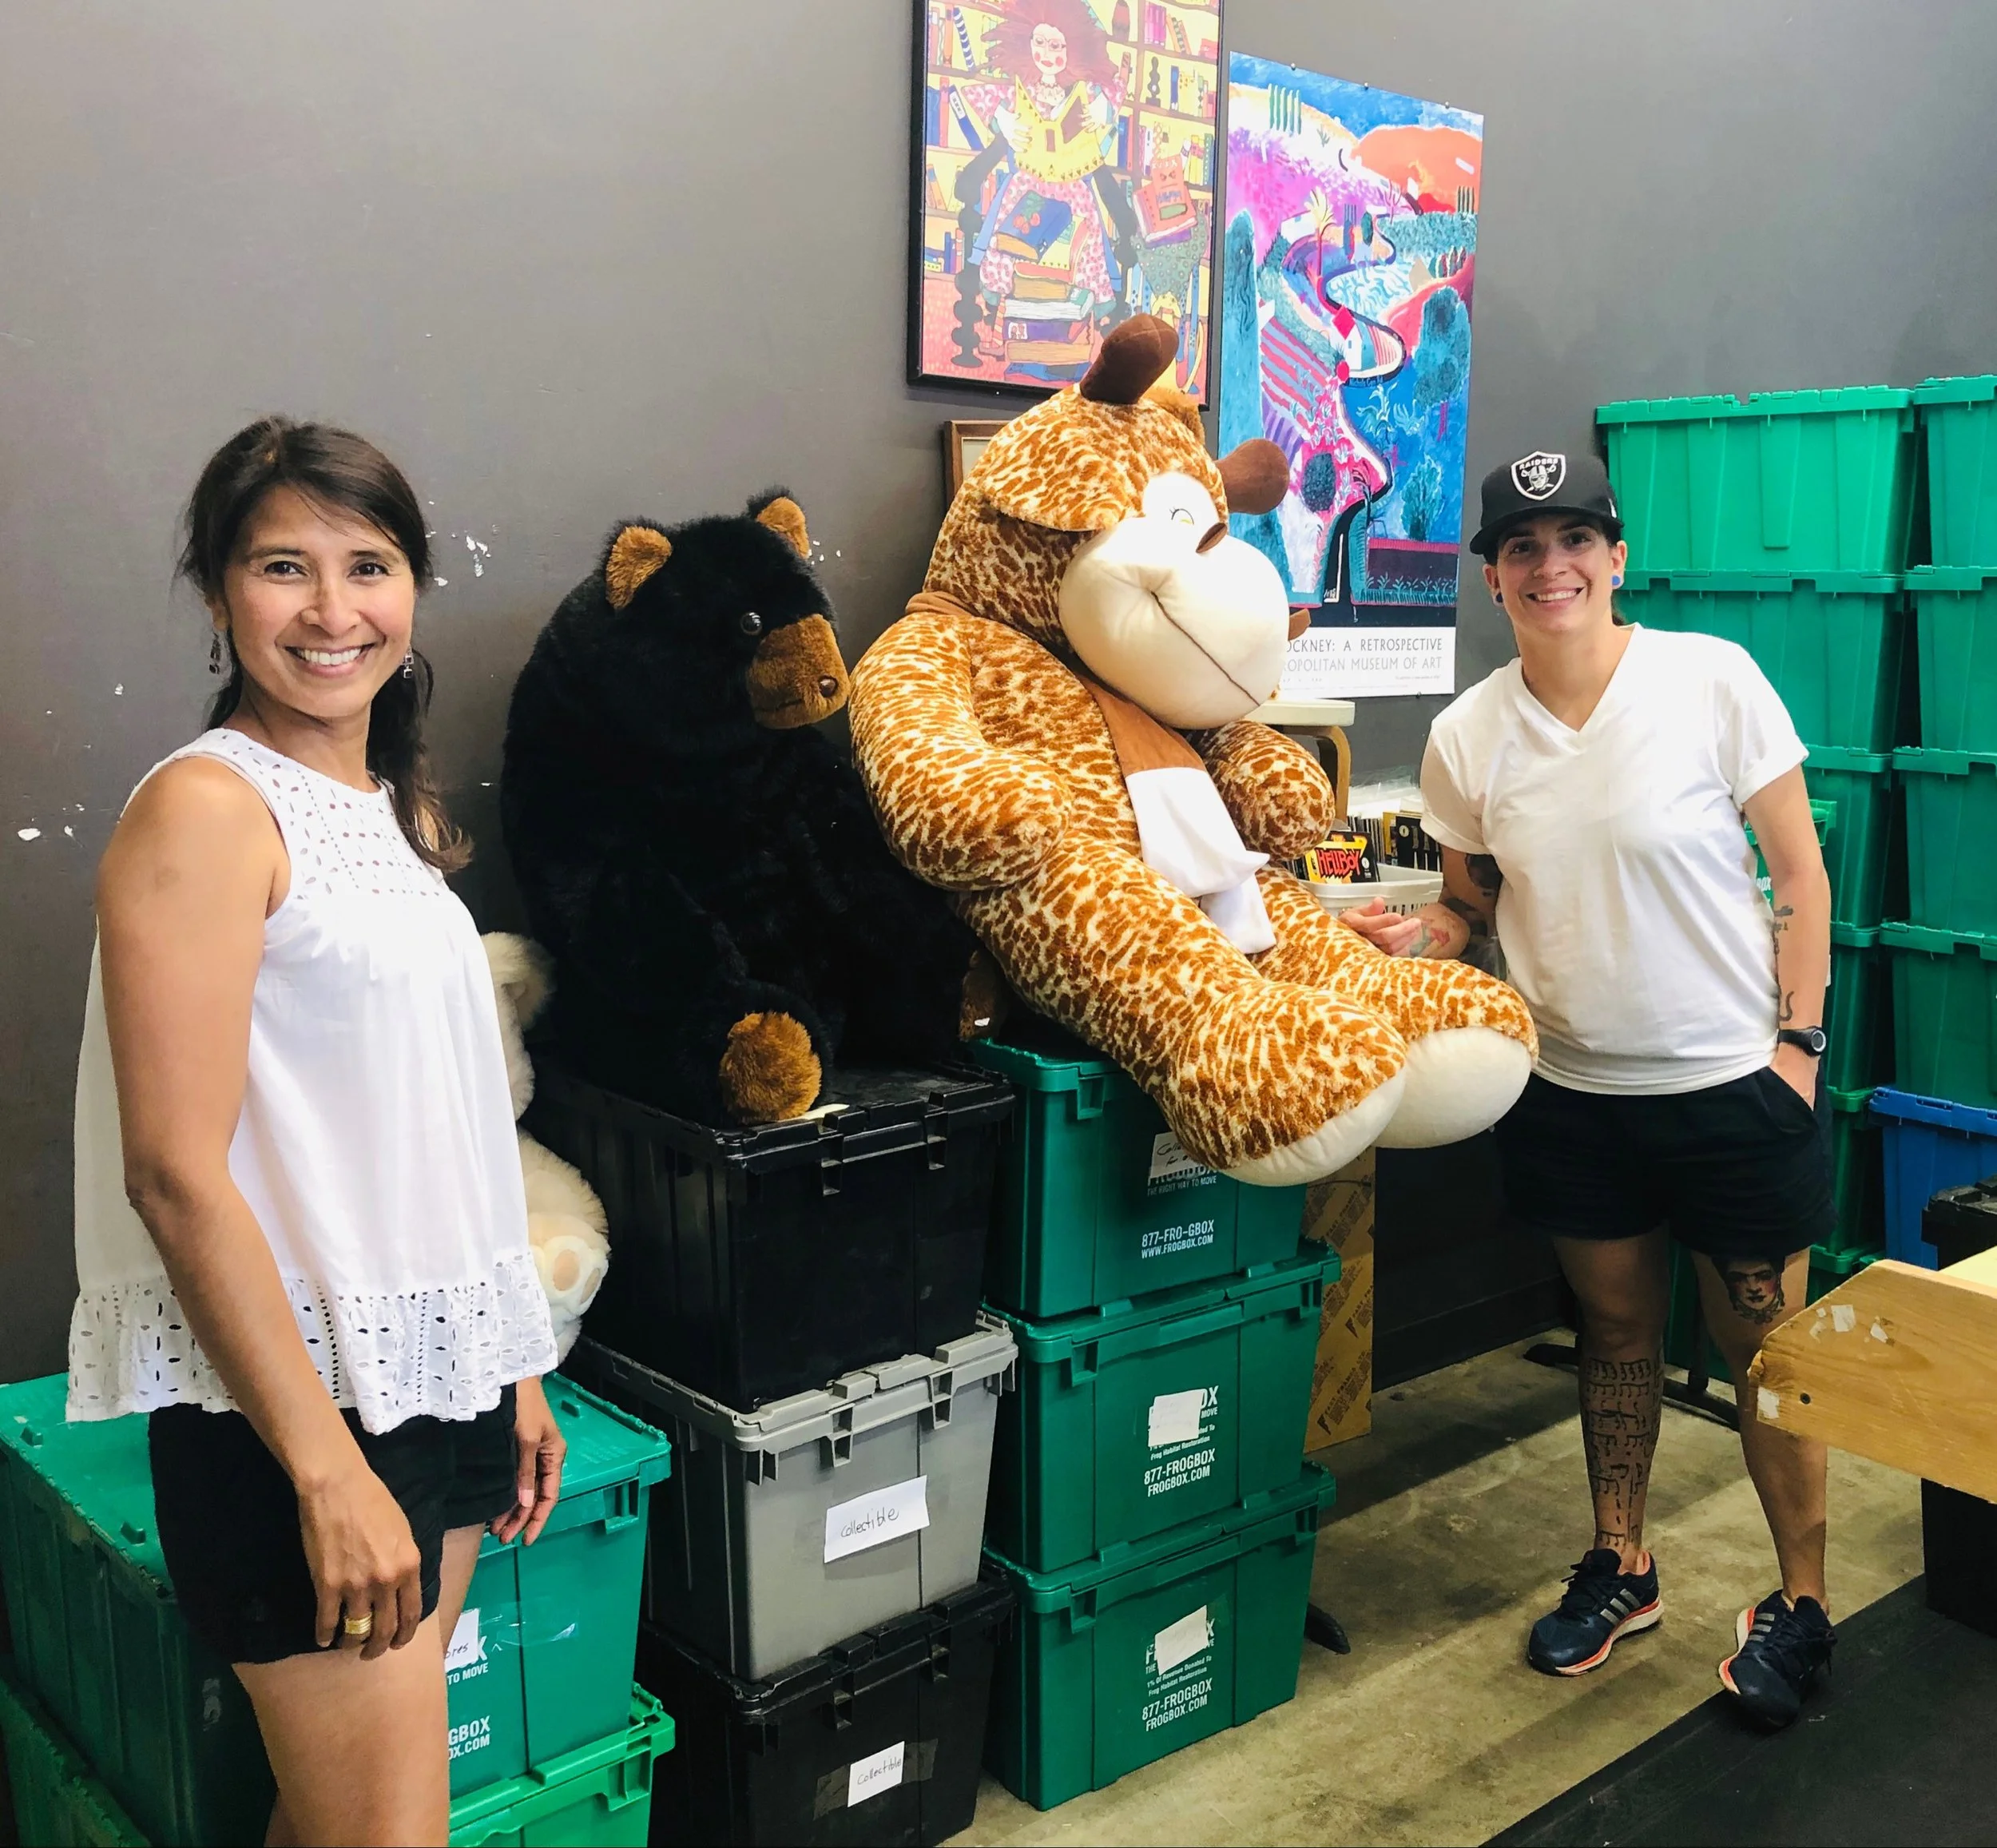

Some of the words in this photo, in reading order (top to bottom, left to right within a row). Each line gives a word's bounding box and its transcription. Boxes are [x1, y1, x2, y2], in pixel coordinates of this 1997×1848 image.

[1519, 458, 1558, 470] RAIDERS
[1286, 639, 1335, 652] OCKNEY:
[1344, 640, 1352, 651] A
[1360, 638, 1442, 651] RETROSPECTIVE
[1284, 658, 1345, 671] OPOLITAN
[1352, 658, 1398, 670] MUSEUM
[1403, 657, 1417, 669] OF
[1422, 657, 1442, 669] ART
[1316, 848, 1360, 878] HELLBOY
[1147, 1187, 1157, 1197] THE
[1158, 1182, 1176, 1194] RIGHT
[1177, 1179, 1190, 1190] WAY
[1192, 1178, 1200, 1187] TO
[1201, 1175, 1217, 1186] MOVE
[1141, 1219, 1214, 1247] 877-FRO-GBOX
[1141, 1234, 1213, 1259] WWW.FROGBOX.COM
[1201, 1407, 1218, 1419] MOVE
[1150, 1452, 1163, 1461] Frog
[1163, 1445, 1181, 1457] Habitat
[1144, 1449, 1215, 1484] 877-FROGBOX
[1148, 1465, 1210, 1497] FROGBOX.COM
[447, 1672, 460, 1685] TO
[463, 1663, 489, 1680] MOVE
[1145, 1663, 1157, 1675] THE
[1184, 1657, 1205, 1671] Donated
[1148, 1687, 1160, 1697] Frog
[1178, 1667, 1207, 1683] Restoration
[1141, 1678, 1213, 1720] 877-FROGBOX
[1145, 1695, 1208, 1731] FROGBOX.COM
